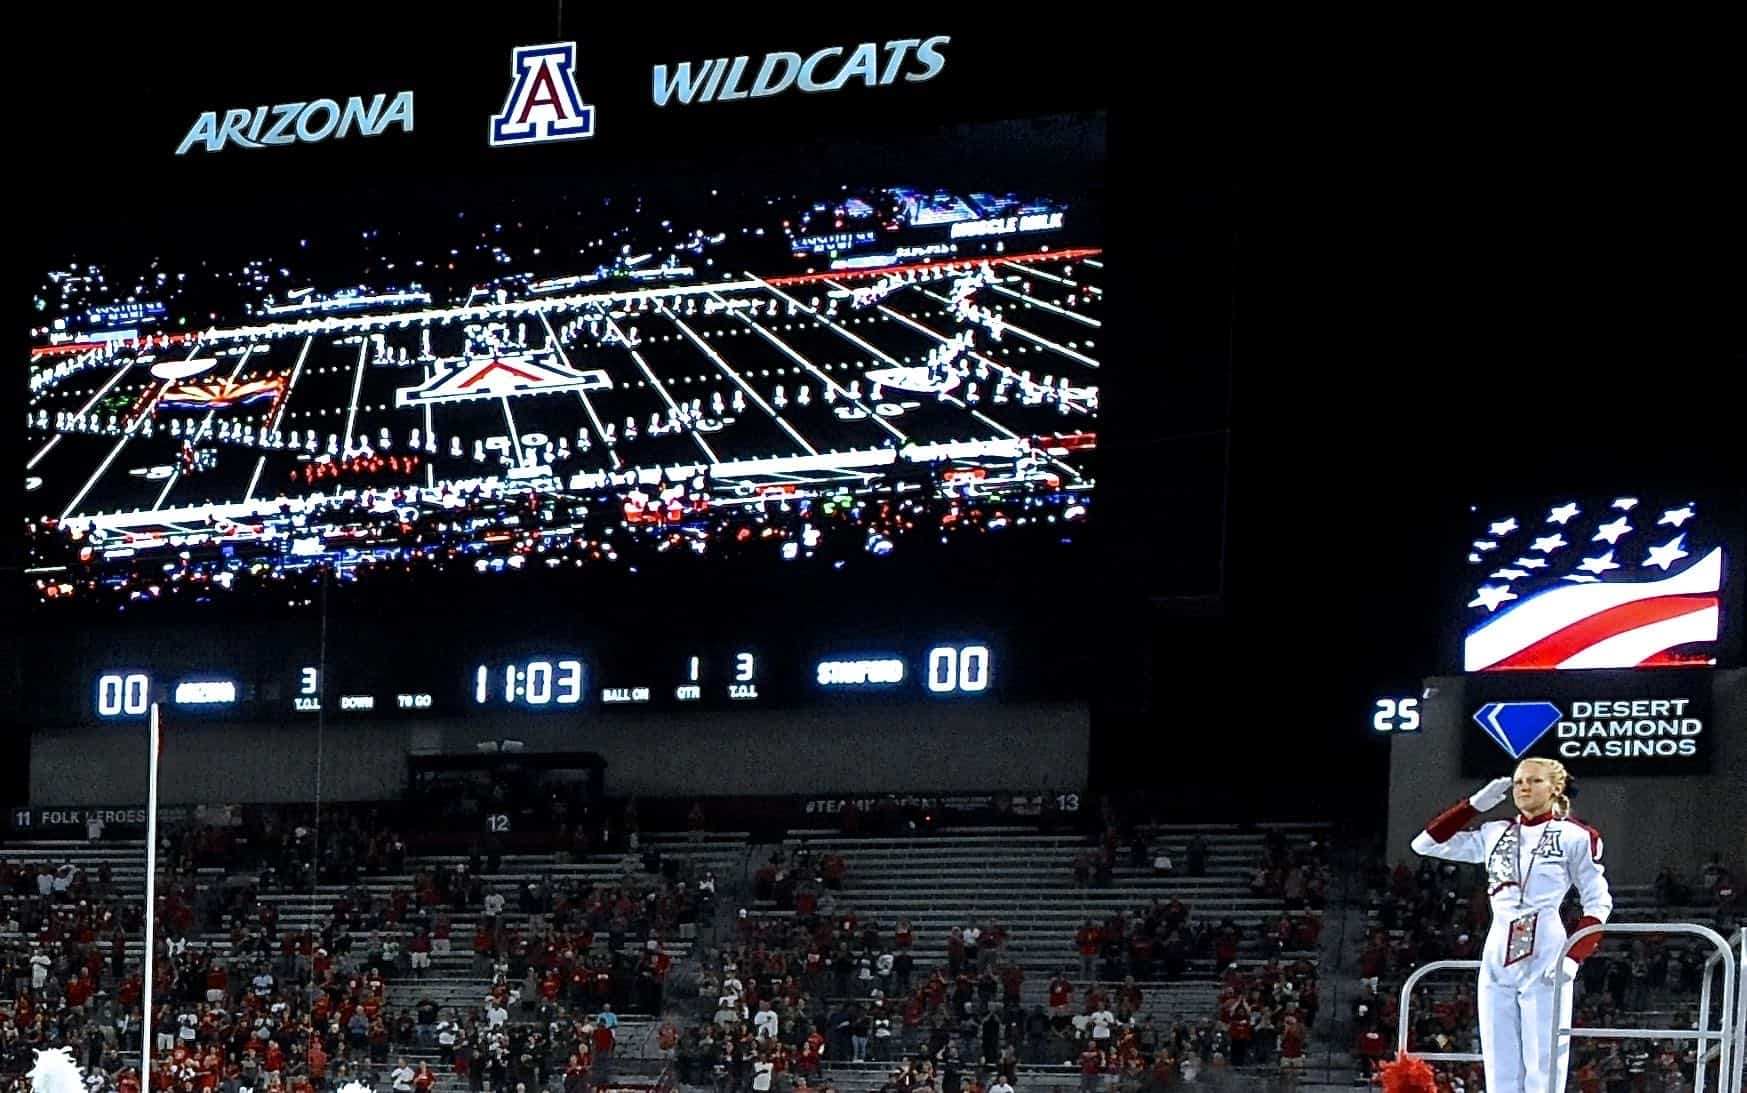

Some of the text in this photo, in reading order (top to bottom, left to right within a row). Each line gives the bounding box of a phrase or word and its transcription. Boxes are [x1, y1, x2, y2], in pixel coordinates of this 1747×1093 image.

[176, 36, 950, 154] ARIZONA A WILDCATS
[690, 657, 699, 681] 1
[736, 653, 754, 681] 3
[929, 647, 989, 692] 00
[302, 667, 317, 694] 3
[477, 661, 581, 704] 11:03
[99, 674, 148, 715] 00
[415, 694, 432, 708] GO
[603, 689, 630, 703] BALL
[677, 686, 700, 700] QTR
[341, 697, 374, 710] DOWN
[1573, 700, 1689, 718] DESERT
[1374, 699, 1420, 731] 25
[1558, 719, 1702, 738] DIAMOND
[1560, 739, 1696, 757] CASINOS
[1056, 794, 1079, 811] 13
[16, 812, 30, 826] 11
[42, 811, 79, 824] FOLK
[488, 815, 508, 831] 12
